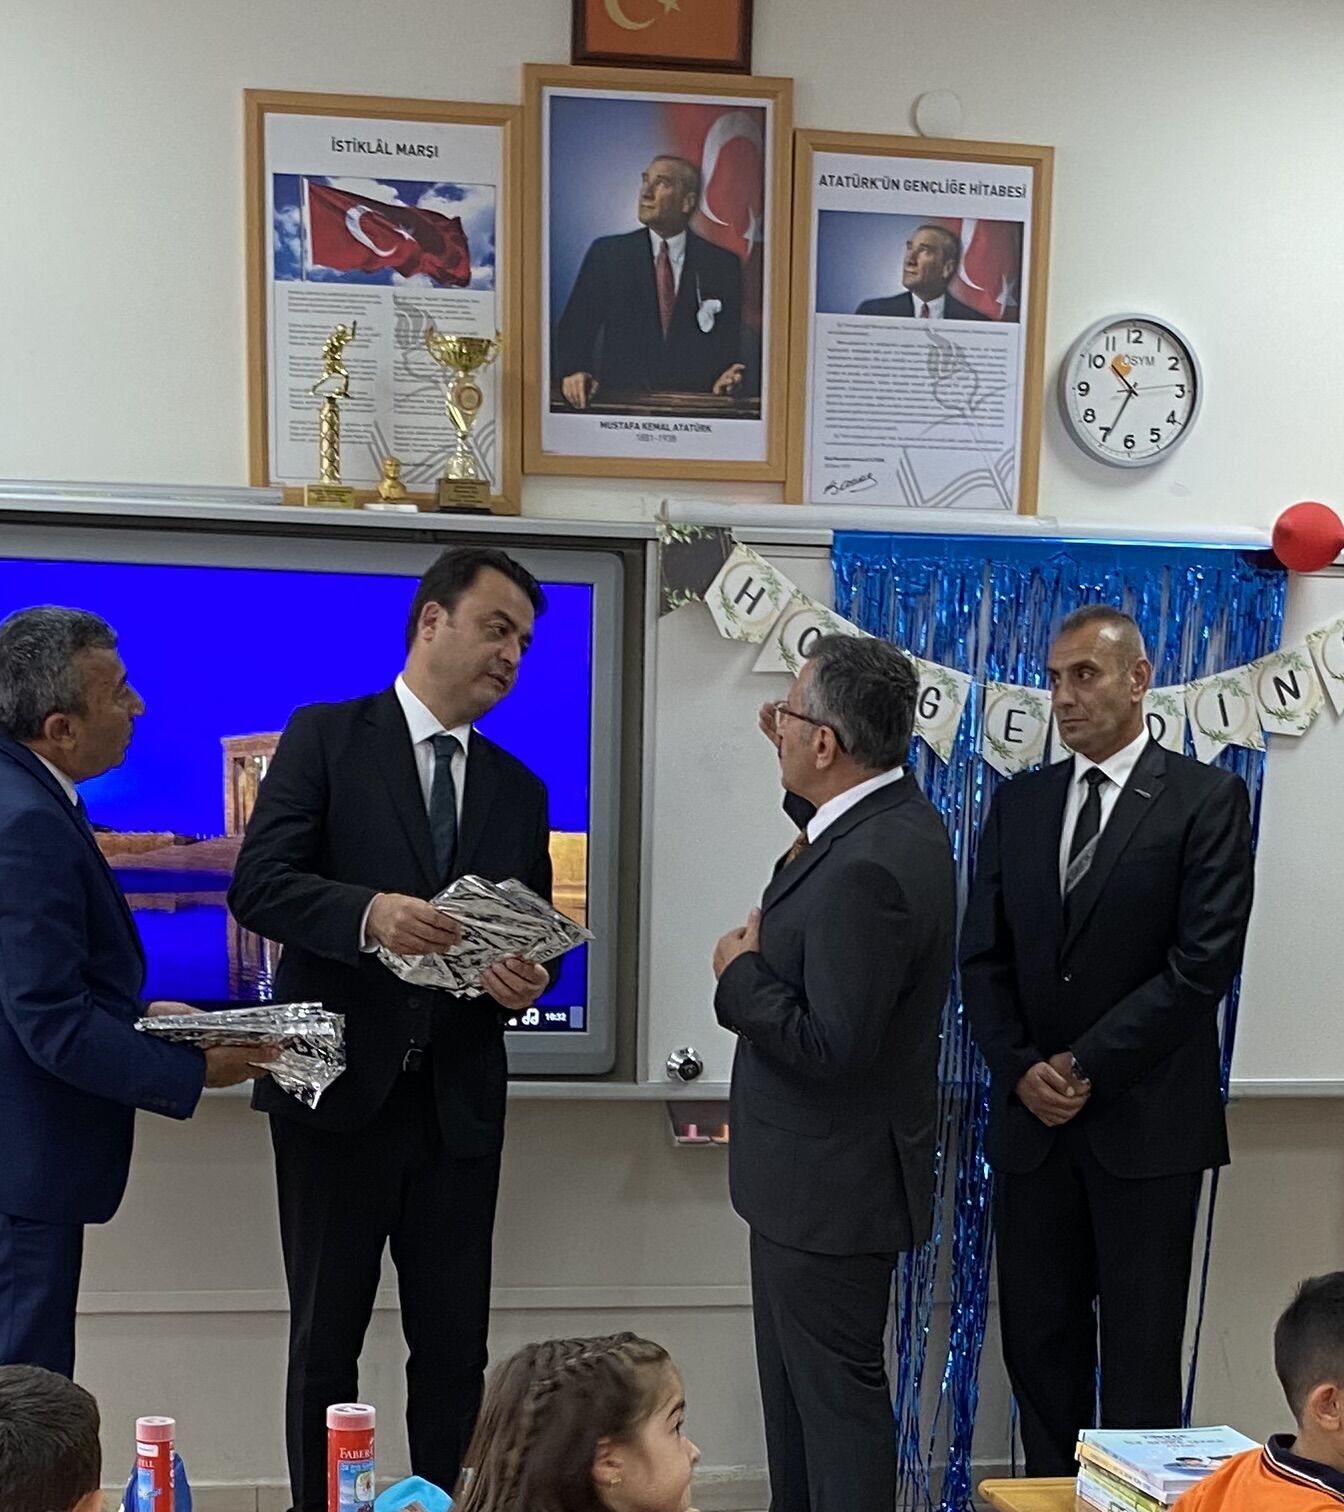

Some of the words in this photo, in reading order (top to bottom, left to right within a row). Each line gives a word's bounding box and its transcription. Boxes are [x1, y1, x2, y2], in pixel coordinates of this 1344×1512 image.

[331, 136, 392, 156] İSTİKLÂL
[396, 143, 439, 159] MARŞI
[818, 173, 900, 191] ATATÜRK'ÜN
[903, 178, 967, 196] GENÇLİĞE
[969, 181, 1027, 199] HİTABESİ
[1106, 336, 1116, 351] 11
[1127, 328, 1144, 344] 12
[1088, 353, 1106, 369] 10
[1168, 356, 1180, 371] 2
[1077, 381, 1090, 397] 9
[1175, 384, 1186, 399] 3
[1083, 408, 1096, 423] 8
[1166, 410, 1177, 425] 4
[599, 421, 641, 430] MUSTAFA
[642, 422, 671, 431] KEMAL
[672, 422, 713, 432] ATATÜRK
[1099, 427, 1112, 442] 7
[1123, 435, 1135, 449] 6
[1149, 428, 1161, 443] 5
